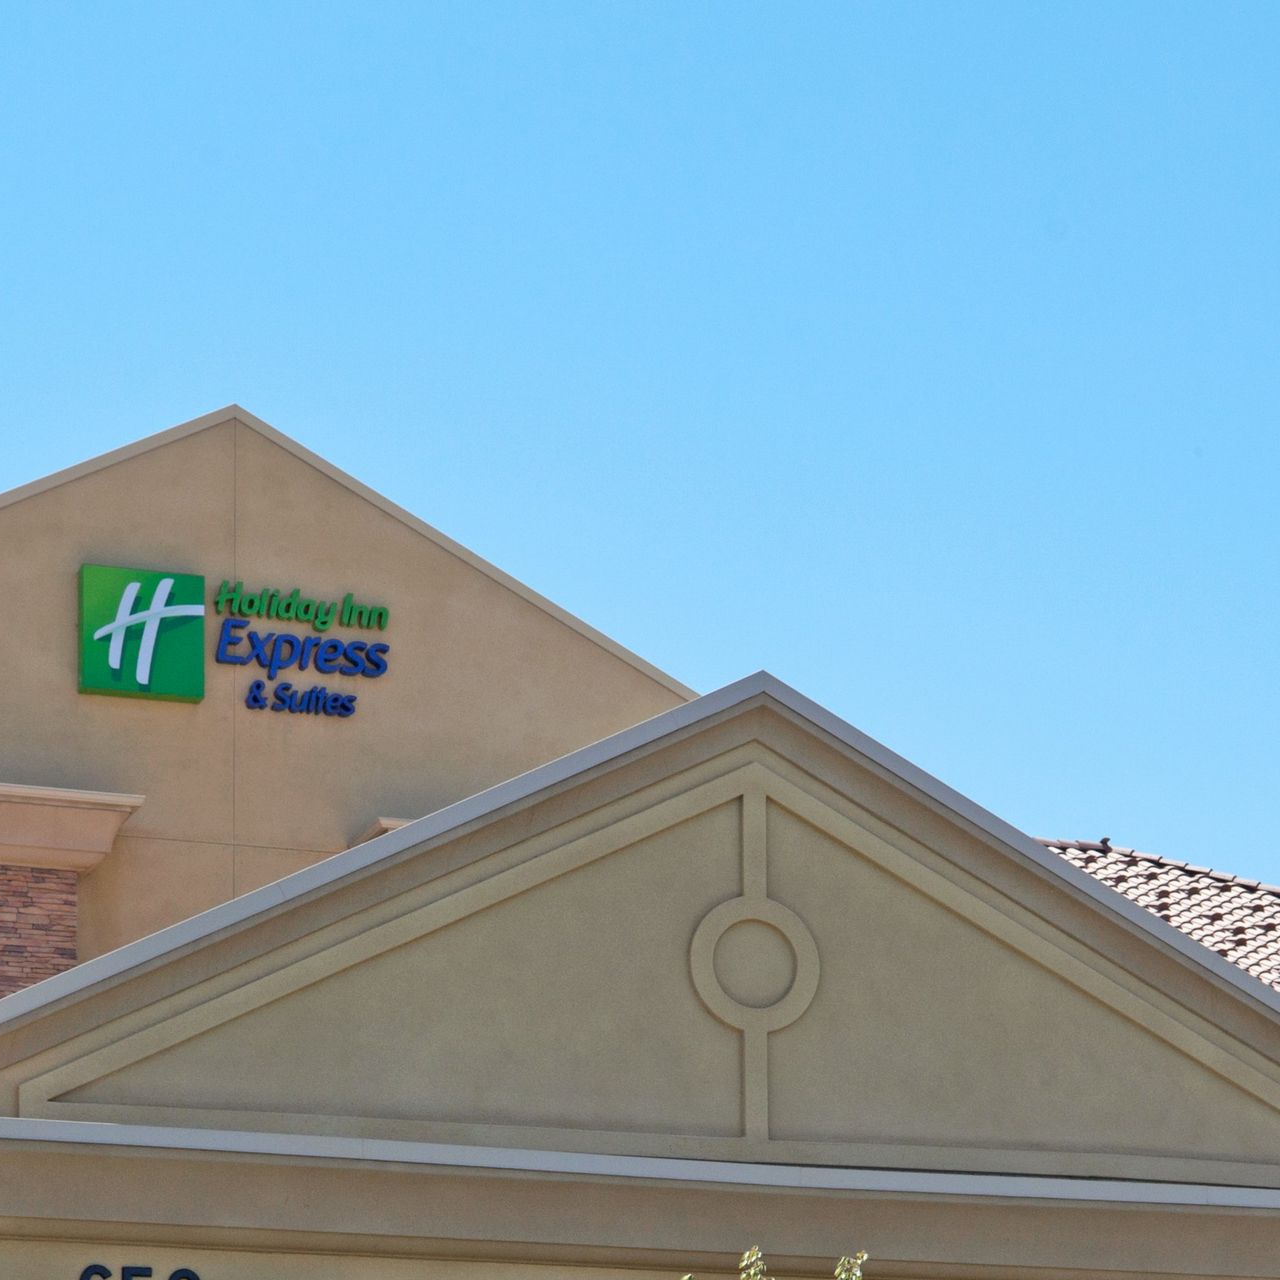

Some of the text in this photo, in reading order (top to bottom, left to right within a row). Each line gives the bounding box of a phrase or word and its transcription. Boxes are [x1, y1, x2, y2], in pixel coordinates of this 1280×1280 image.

[215, 580, 390, 631] Holiday Inn
[215, 617, 390, 680] Express
[245, 680, 357, 717] & Suites
